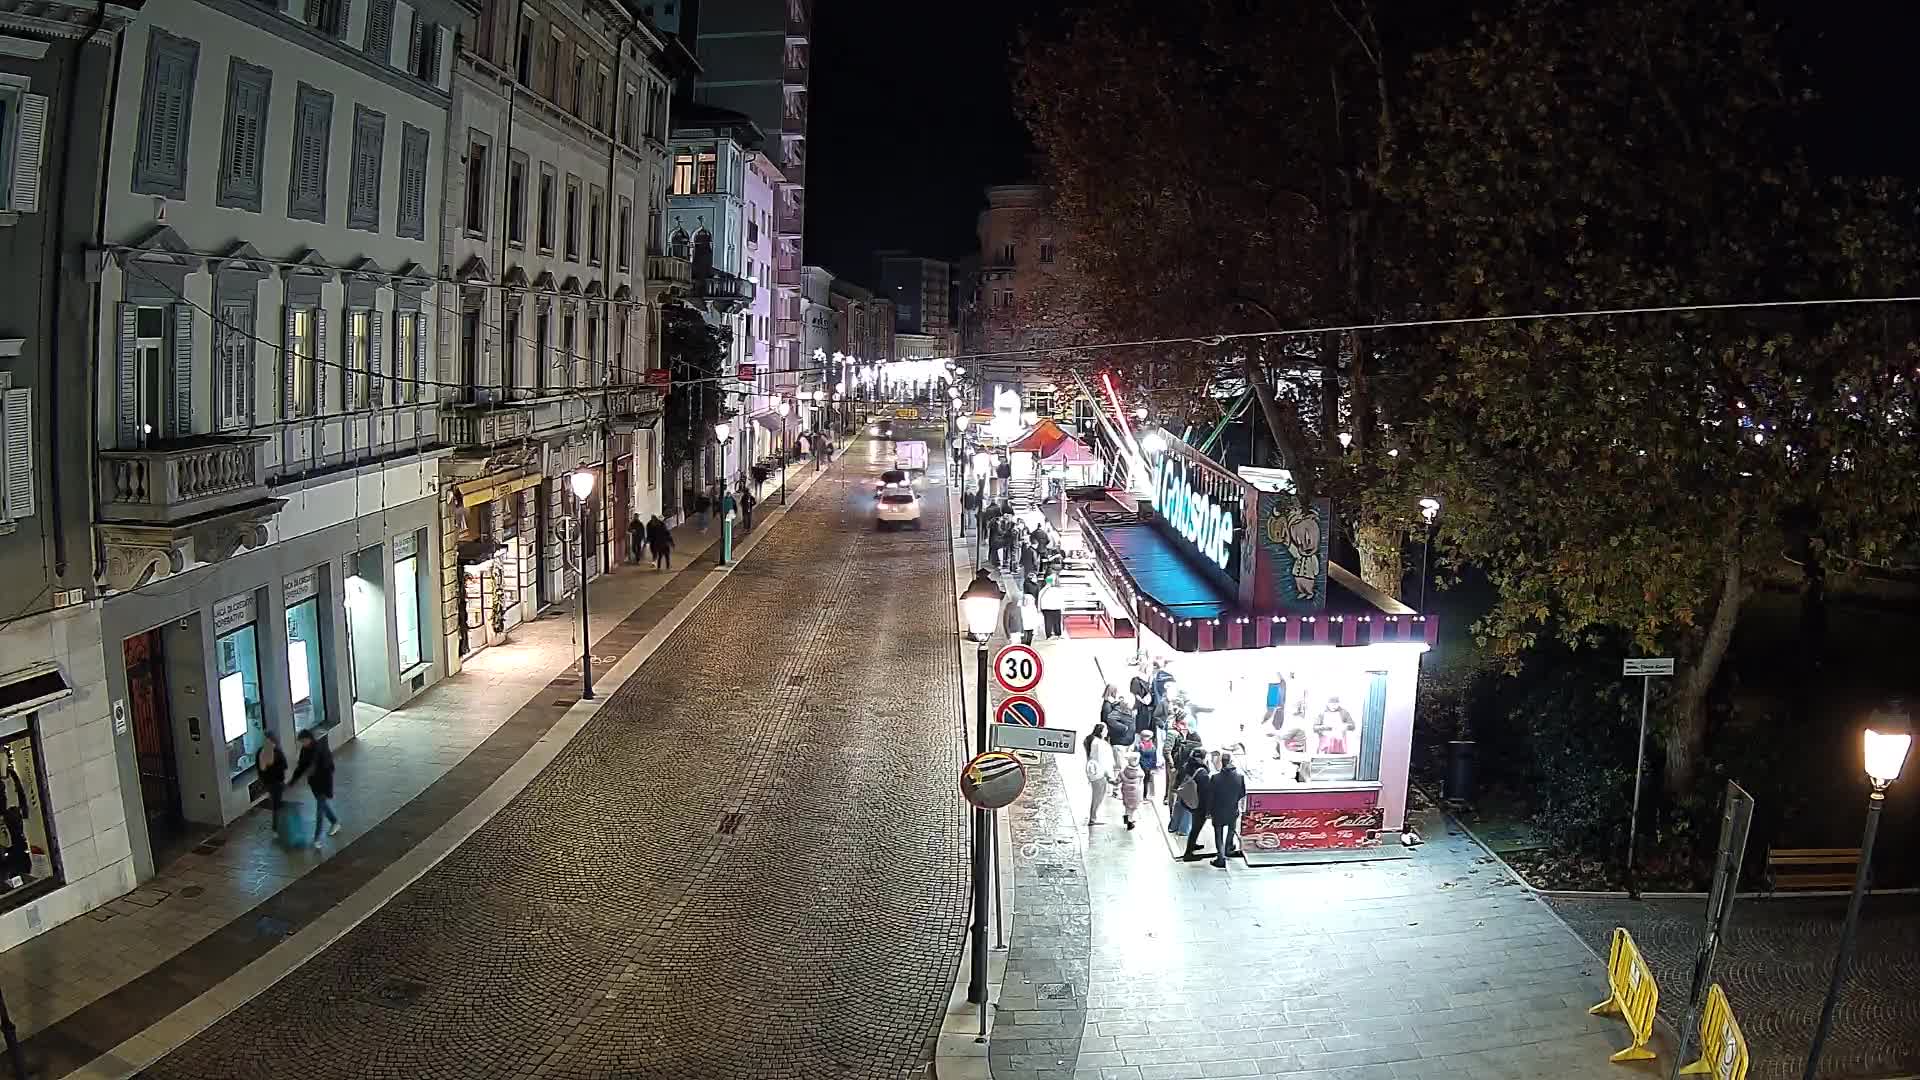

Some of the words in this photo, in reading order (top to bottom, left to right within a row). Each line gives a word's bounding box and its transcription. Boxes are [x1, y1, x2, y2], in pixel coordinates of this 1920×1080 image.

[1162, 455, 1233, 570] Golosone
[1005, 658, 1033, 680] 30
[1038, 737, 1070, 749] Dante
